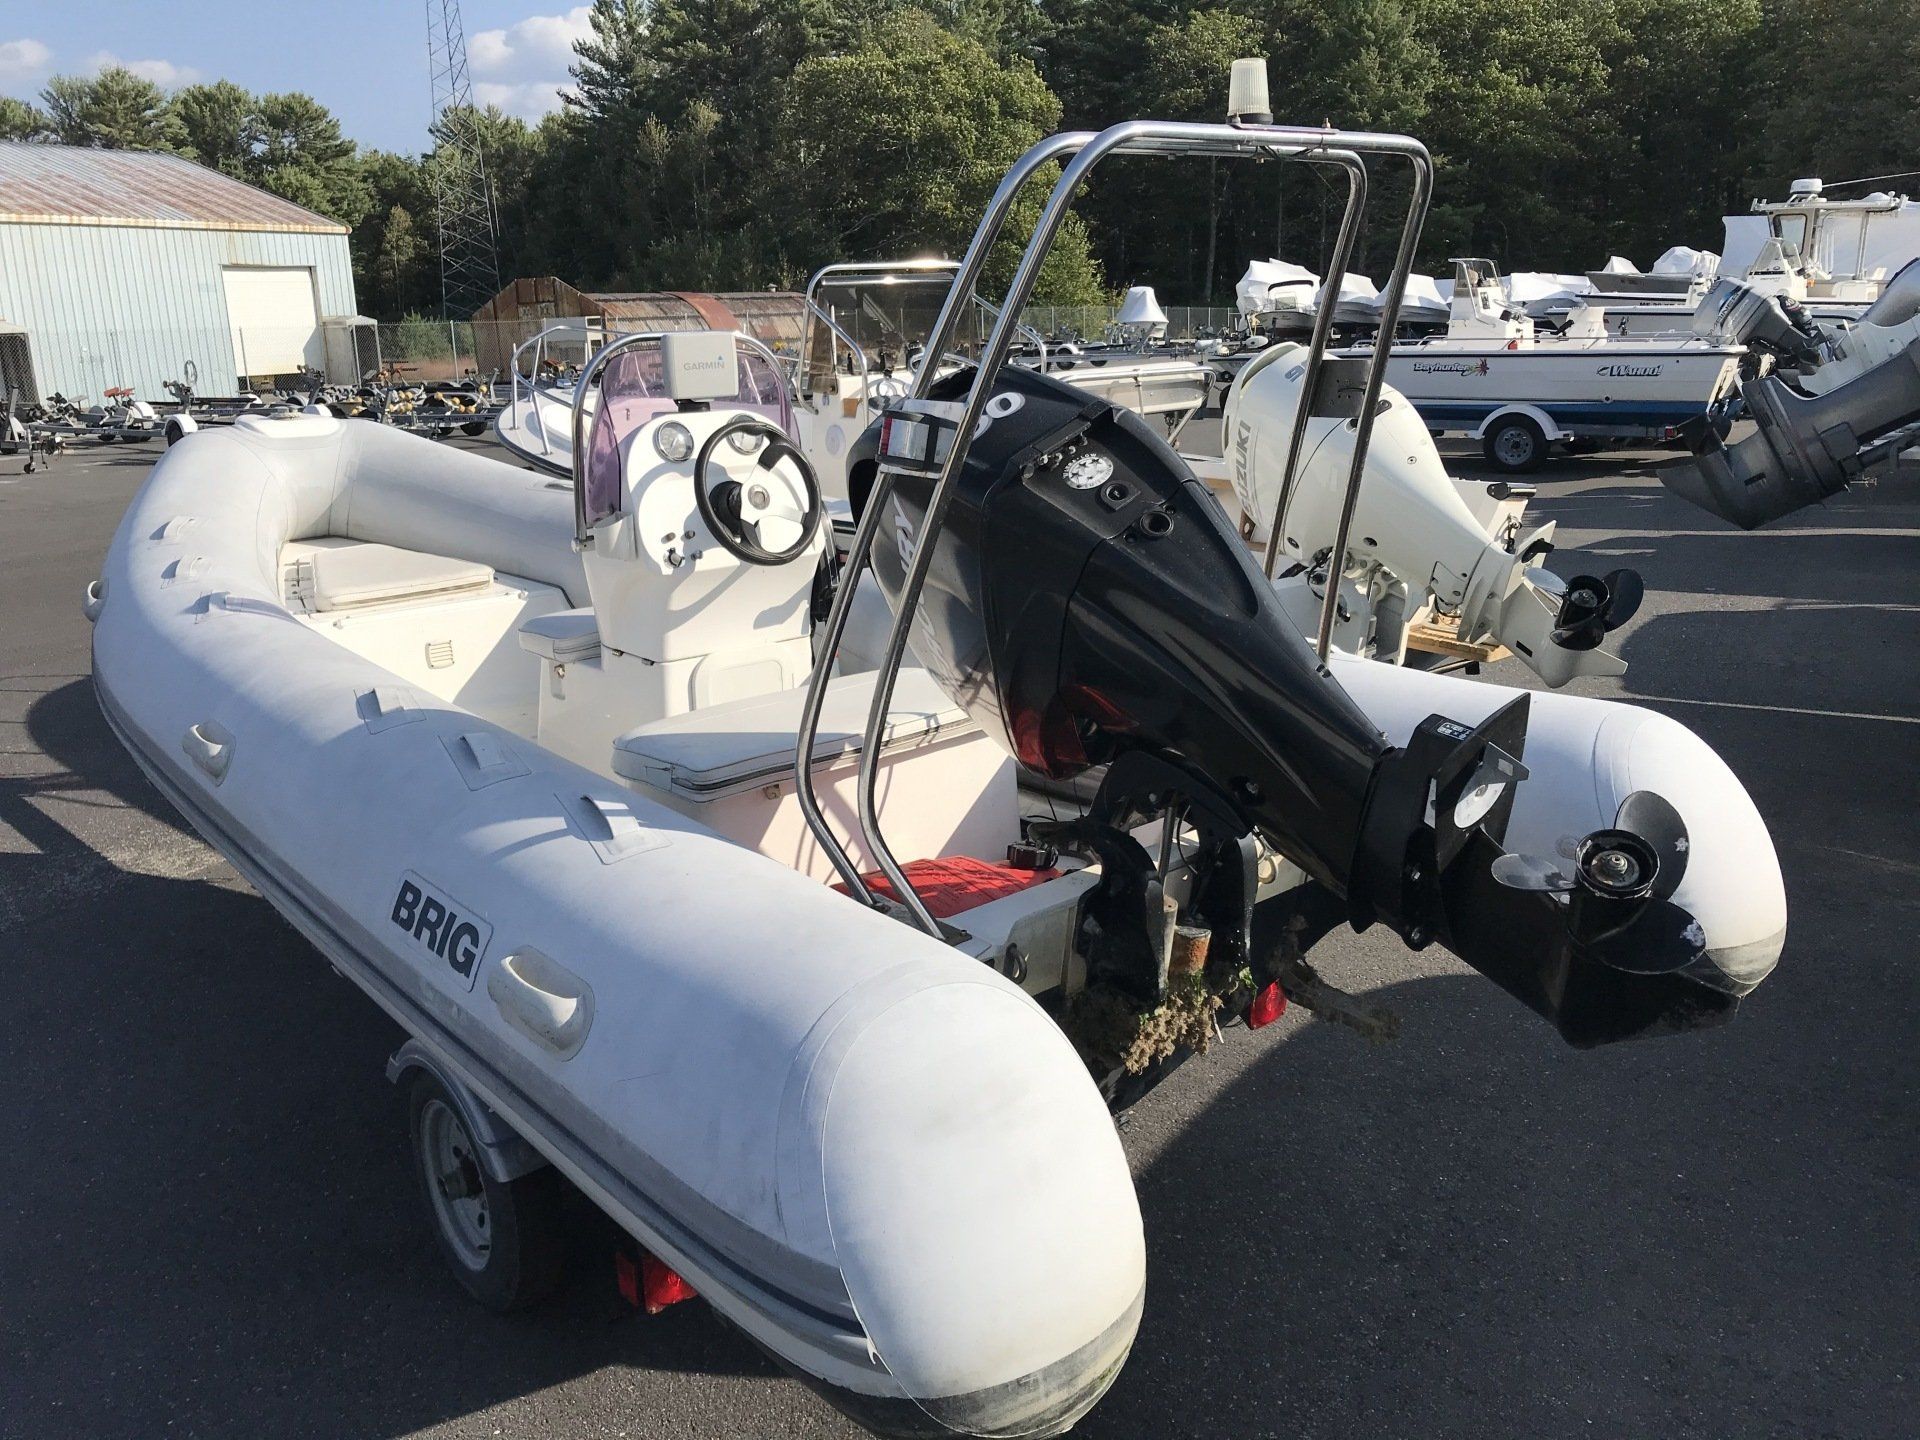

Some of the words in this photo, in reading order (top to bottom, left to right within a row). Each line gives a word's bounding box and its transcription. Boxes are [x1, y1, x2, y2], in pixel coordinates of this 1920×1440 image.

[683, 361, 725, 371] GARMIN
[1413, 362, 1470, 375] Bayhunter
[1234, 419, 1252, 514] SUZUKI
[391, 880, 480, 979] BRIG
